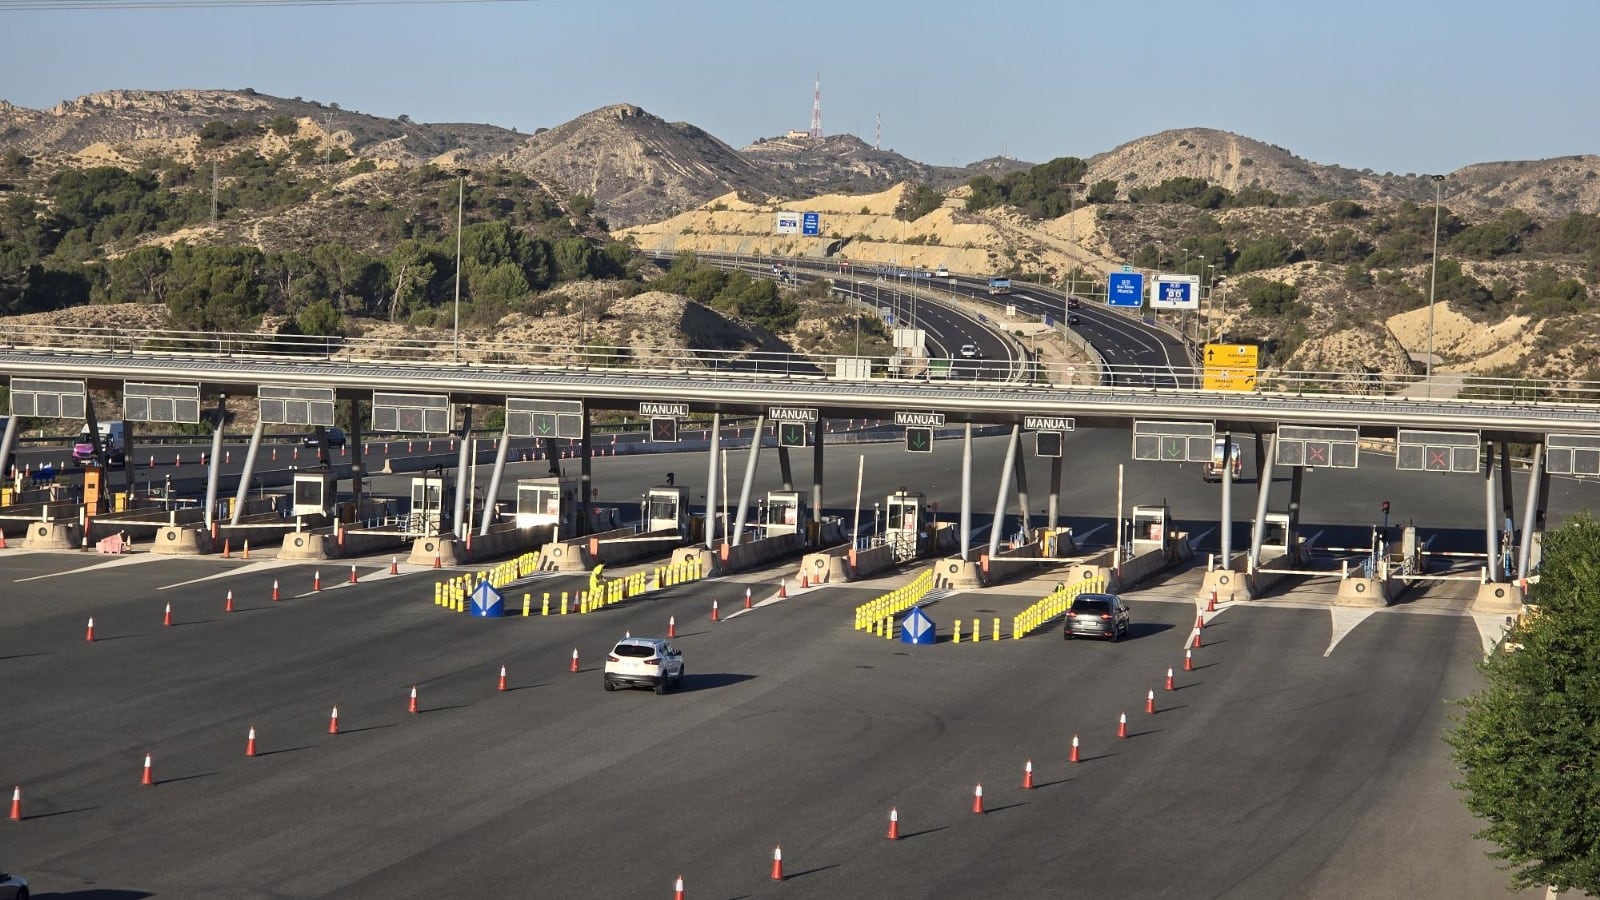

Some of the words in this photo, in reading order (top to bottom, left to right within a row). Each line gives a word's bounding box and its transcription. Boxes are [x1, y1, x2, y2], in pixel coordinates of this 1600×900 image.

[642, 404, 686, 416] MANUAL
[771, 409, 816, 420] MANUAL
[897, 414, 942, 425] MANUAL
[1026, 418, 1073, 429] MANUAL
